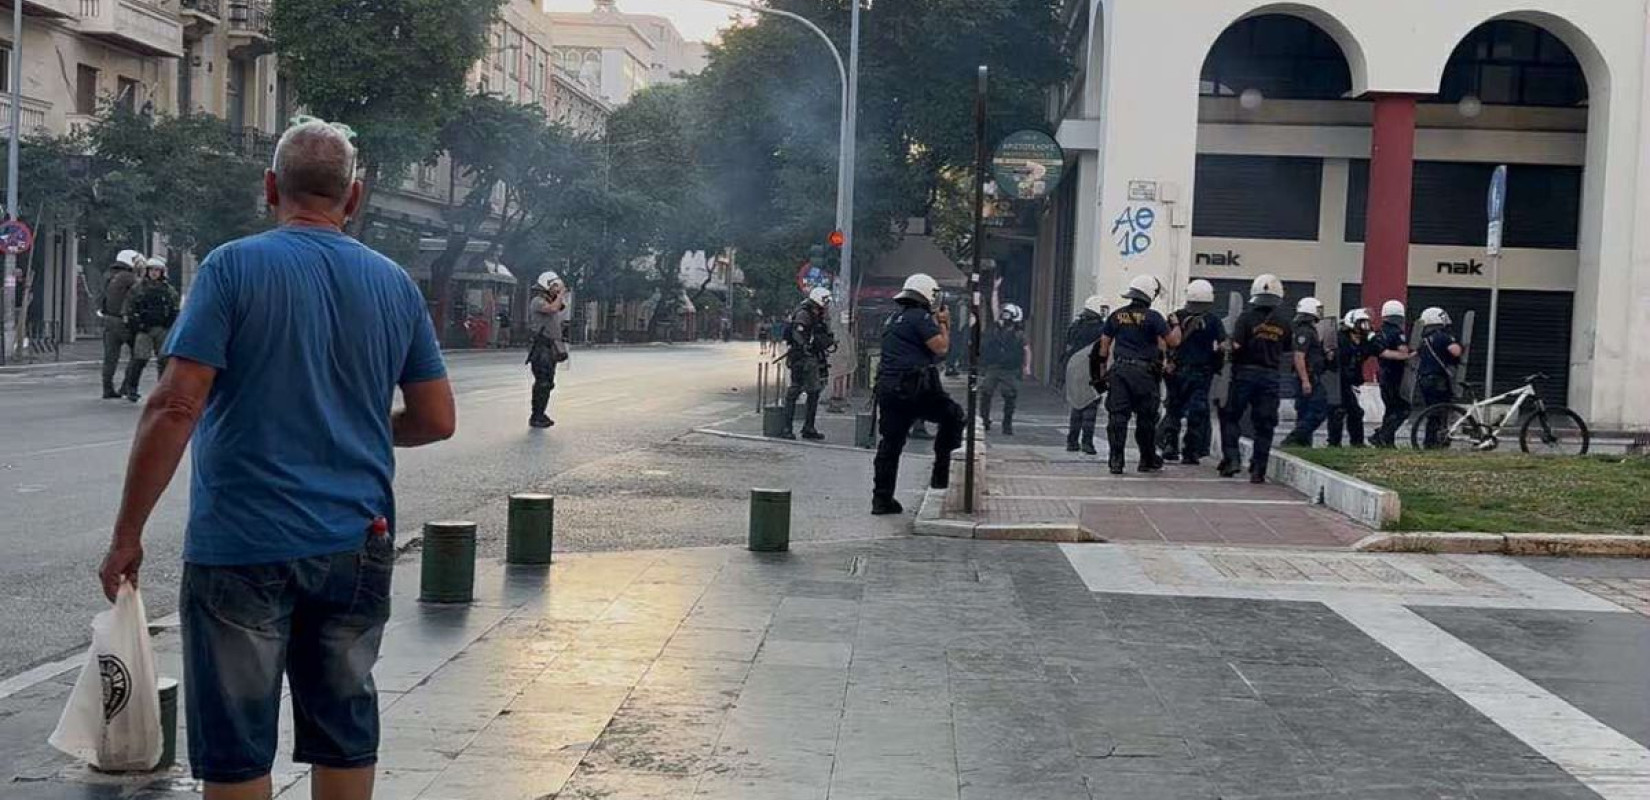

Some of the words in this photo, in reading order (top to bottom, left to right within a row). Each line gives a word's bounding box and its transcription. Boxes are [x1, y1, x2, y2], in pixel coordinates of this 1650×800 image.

[1117, 231, 1152, 256] 10
[1195, 250, 1241, 266] nak
[1437, 258, 1483, 276] nak
